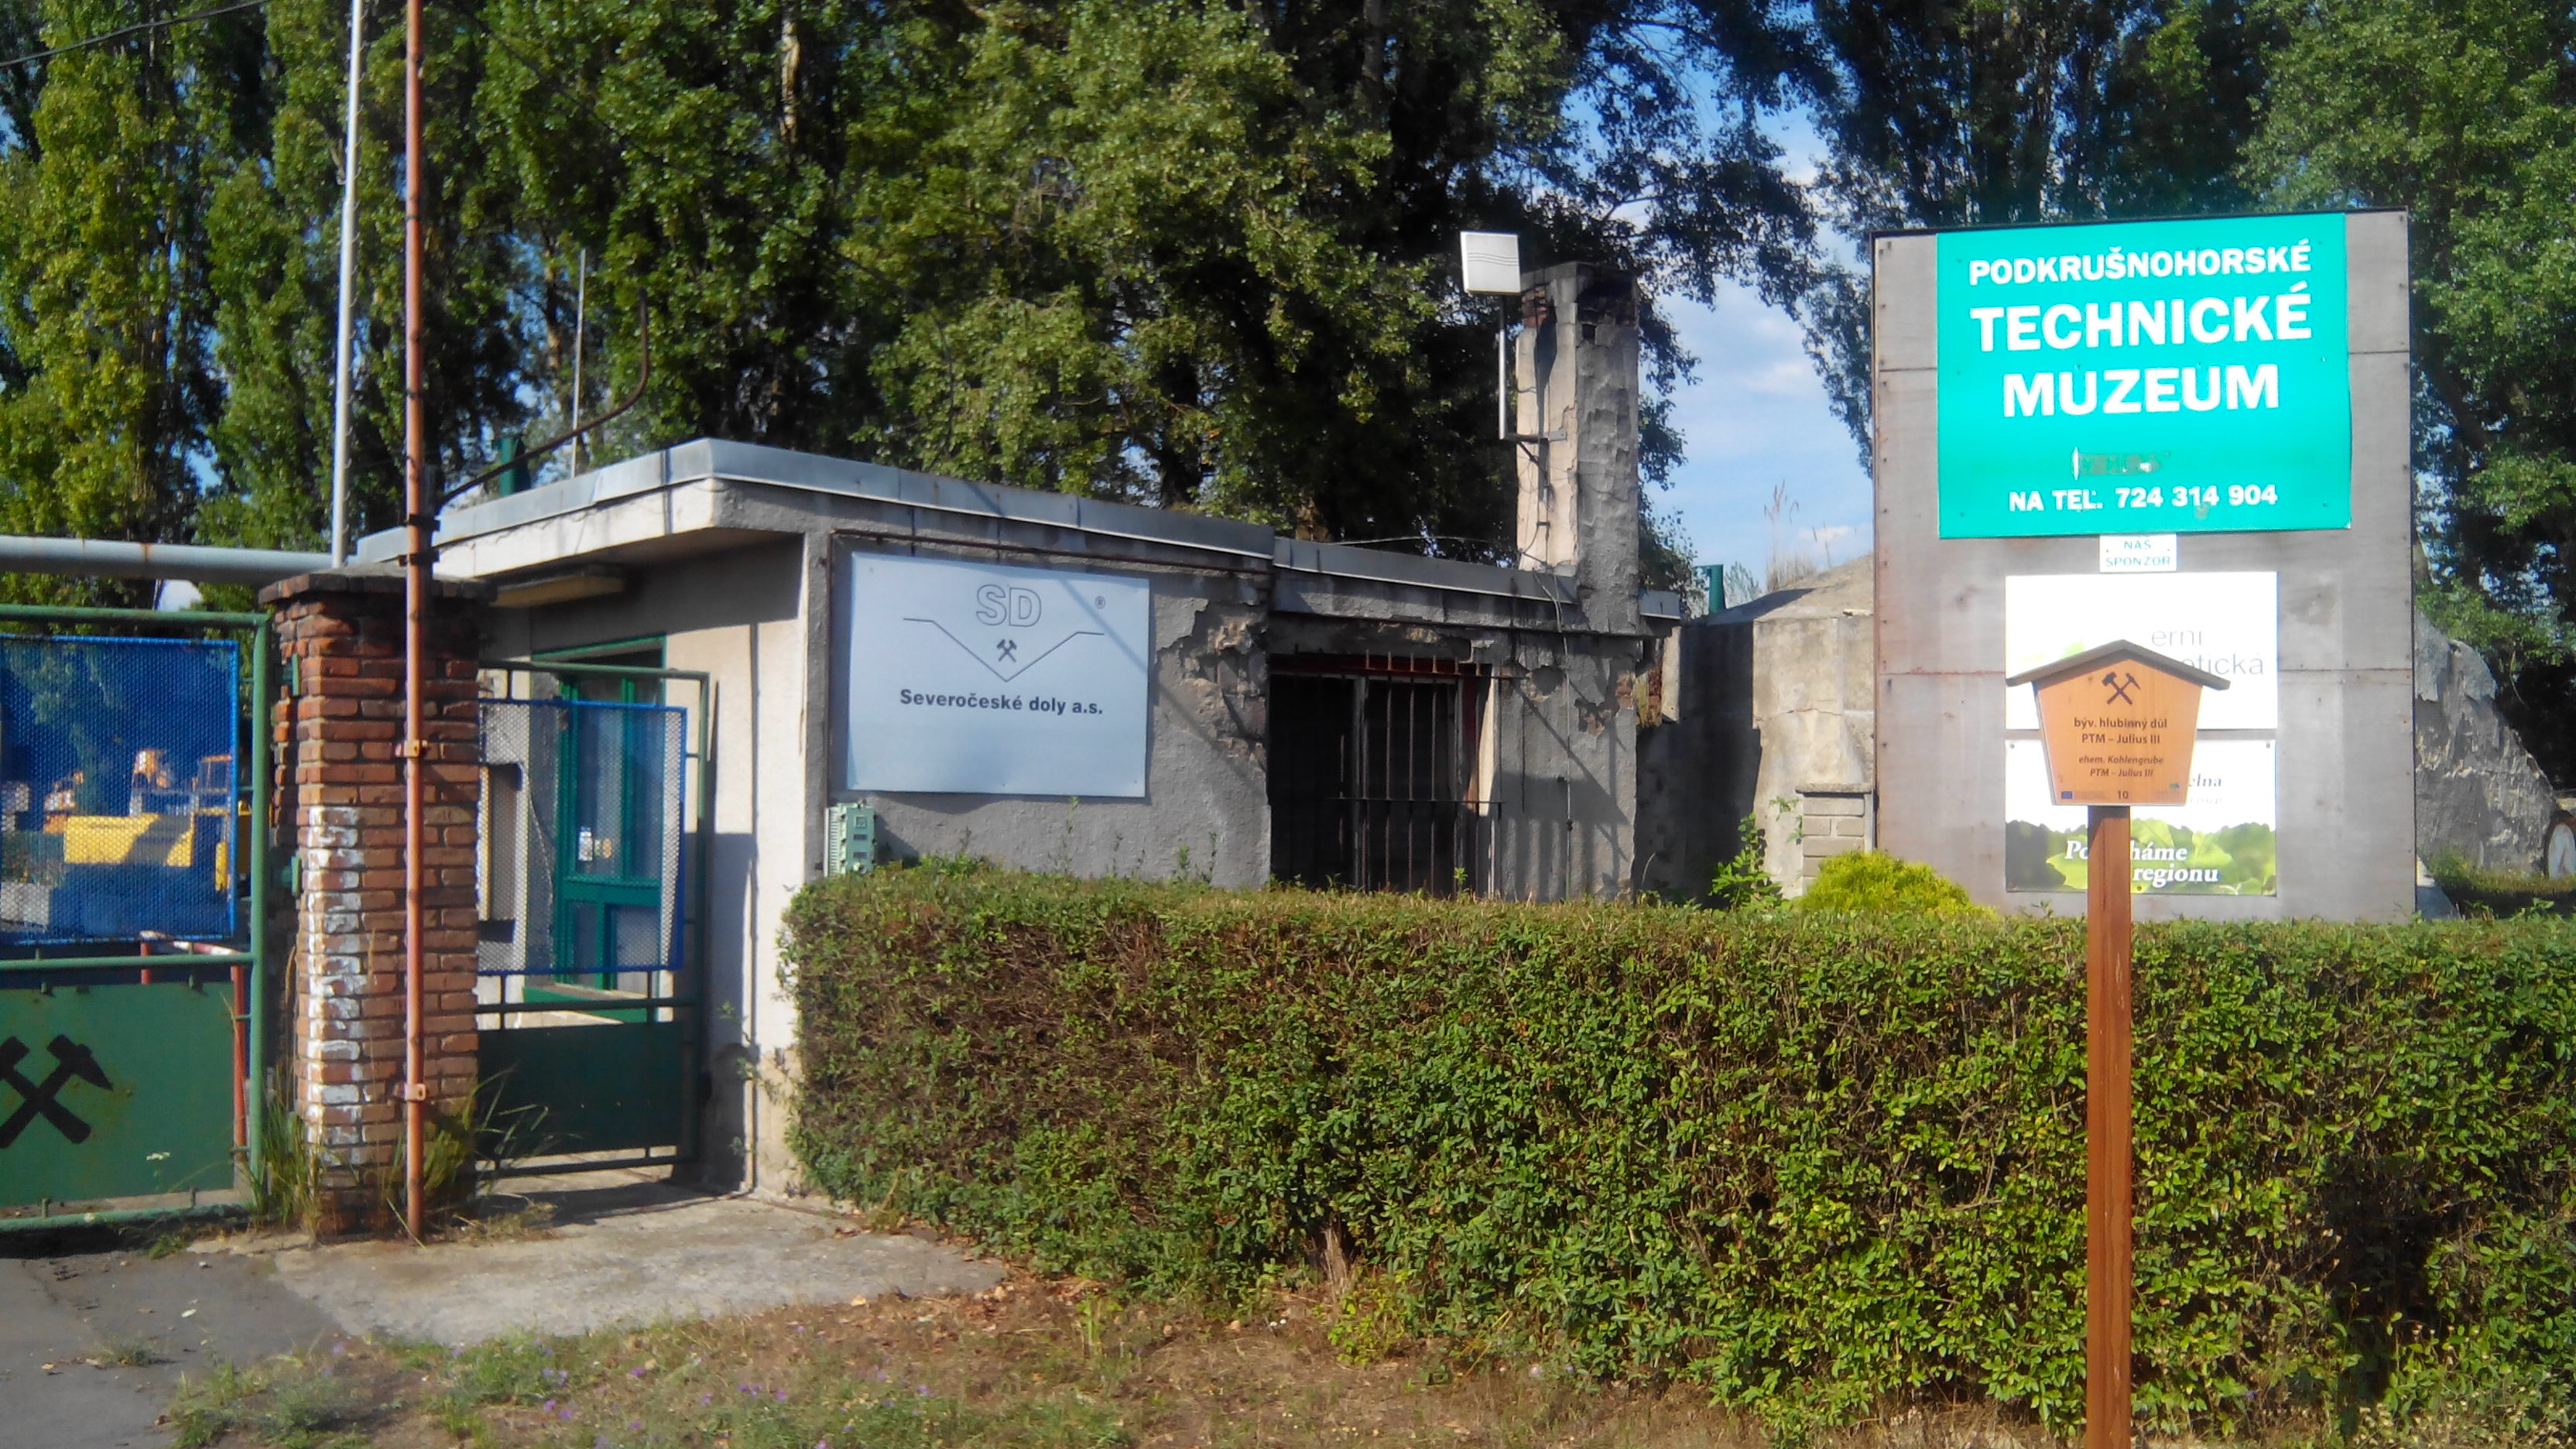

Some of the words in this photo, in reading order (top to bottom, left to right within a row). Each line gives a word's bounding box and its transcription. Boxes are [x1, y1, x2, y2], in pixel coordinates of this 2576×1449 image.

[1968, 238, 2312, 286] PODKRUŠNOHORSKÉ
[1969, 280, 2312, 352] TECHNICKÉ
[2003, 364, 2280, 417] MUZEUM
[2009, 491, 2044, 512] NA
[2051, 489, 2103, 511] TEL.
[2115, 486, 2163, 508] 724
[2171, 485, 2219, 507] 314
[2228, 484, 2278, 505] 904
[2105, 556, 2170, 567] SPONZOR
[975, 584, 1042, 627] SD
[900, 689, 1023, 711] Severočeské
[1029, 697, 1066, 715] doly
[1072, 702, 1103, 714] a.s.
[2074, 717, 2097, 730] býv.
[2099, 717, 2147, 731] hlubinný
[2082, 733, 2105, 743] PTM
[2116, 734, 2147, 744] Julius
[2150, 734, 2160, 744] III
[2090, 768, 2110, 777] PTM
[2117, 768, 2143, 777] Julius
[2107, 755, 2164, 766] Kohlengrube
[2117, 790, 2129, 800] 10
[2133, 862, 2220, 888] regionu
